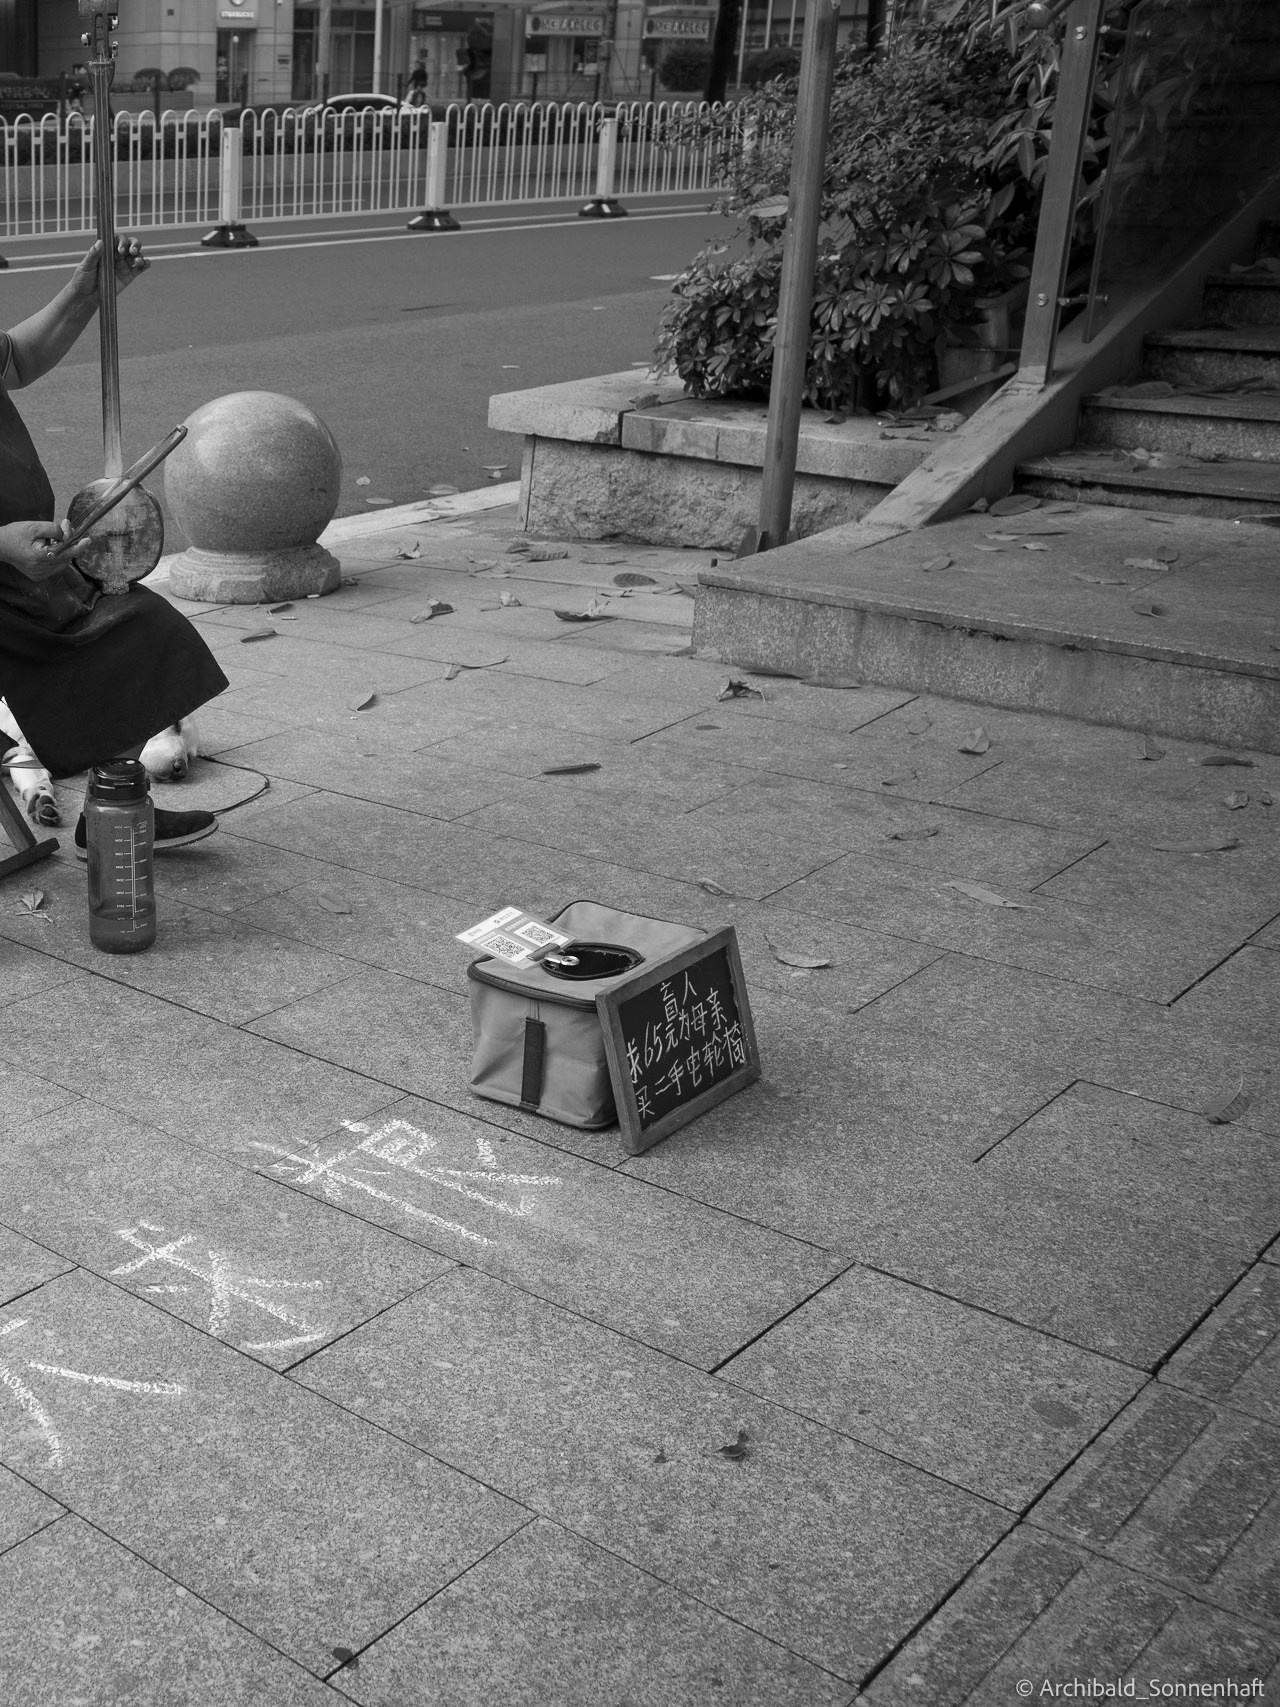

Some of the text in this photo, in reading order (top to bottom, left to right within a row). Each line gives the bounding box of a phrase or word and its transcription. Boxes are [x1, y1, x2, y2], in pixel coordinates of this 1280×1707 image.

[660, 970, 698, 1022] 盲人
[635, 1019, 746, 1119] 买二手电轮椅
